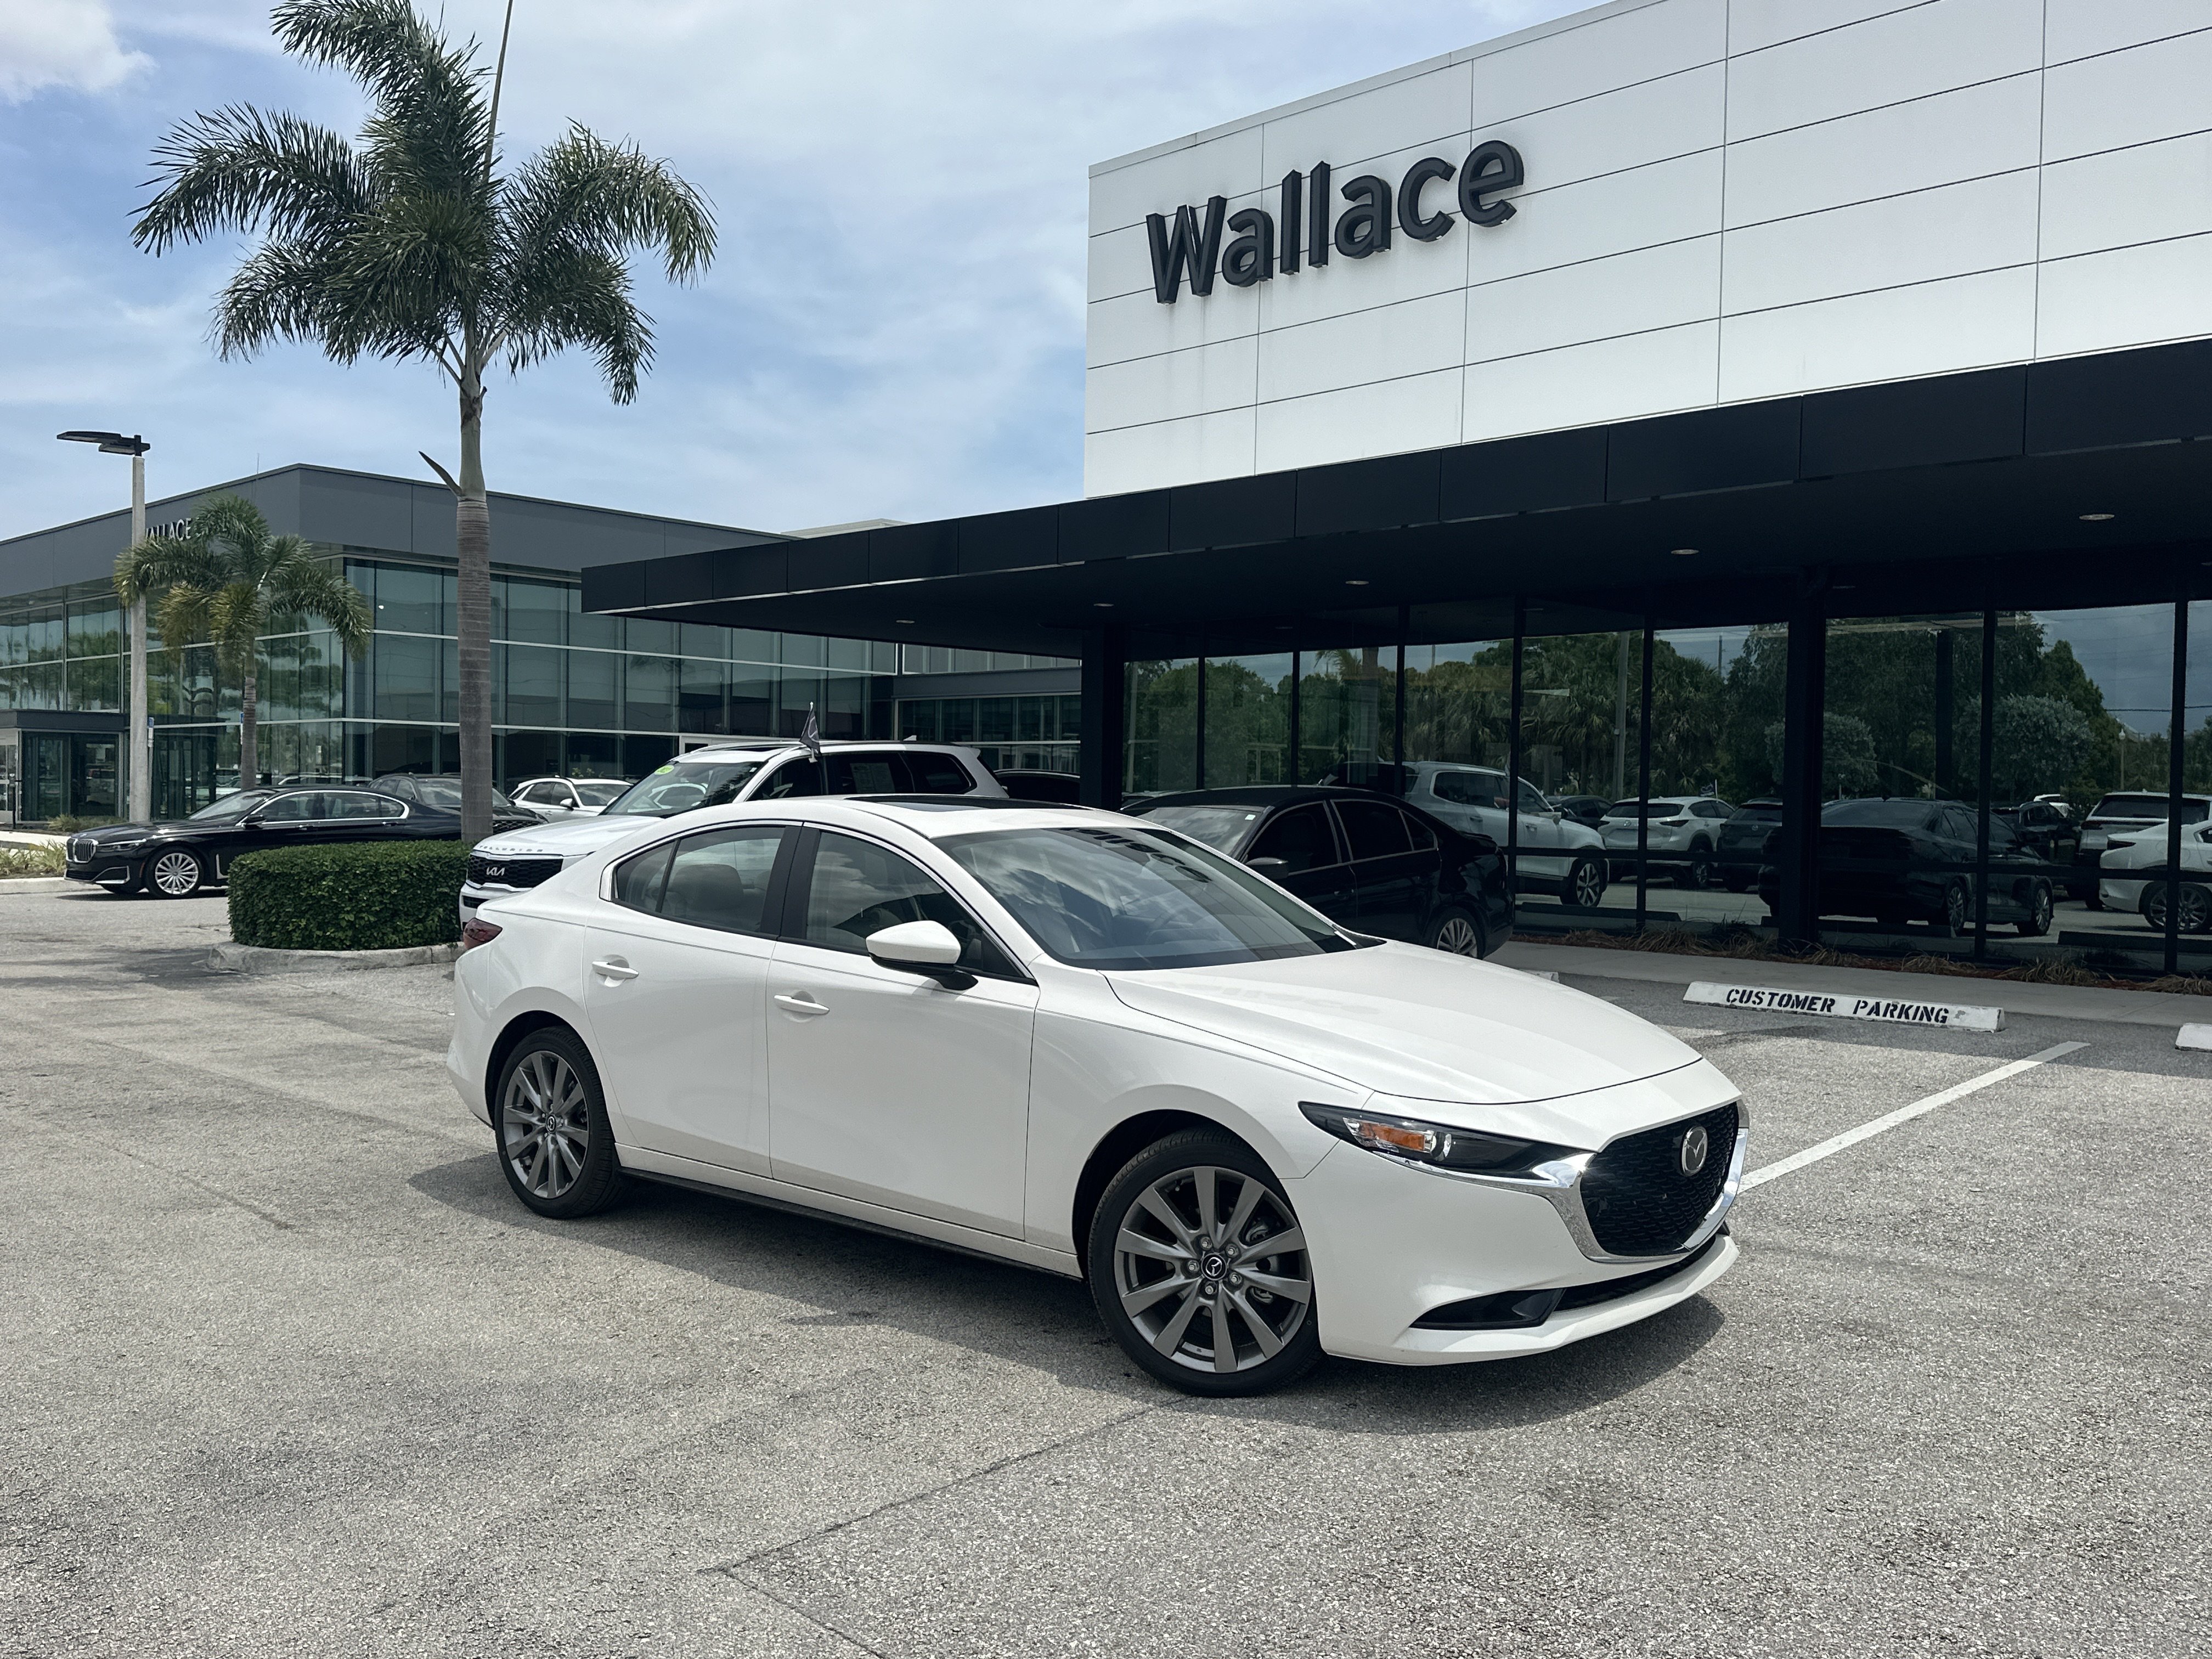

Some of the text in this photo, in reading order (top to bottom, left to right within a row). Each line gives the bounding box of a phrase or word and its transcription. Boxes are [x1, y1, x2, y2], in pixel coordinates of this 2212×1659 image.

[1146, 140, 1525, 305] Wallace
[145, 517, 191, 544] ALLACE
[1726, 989, 1949, 1024] CUSTOMER PARKING
